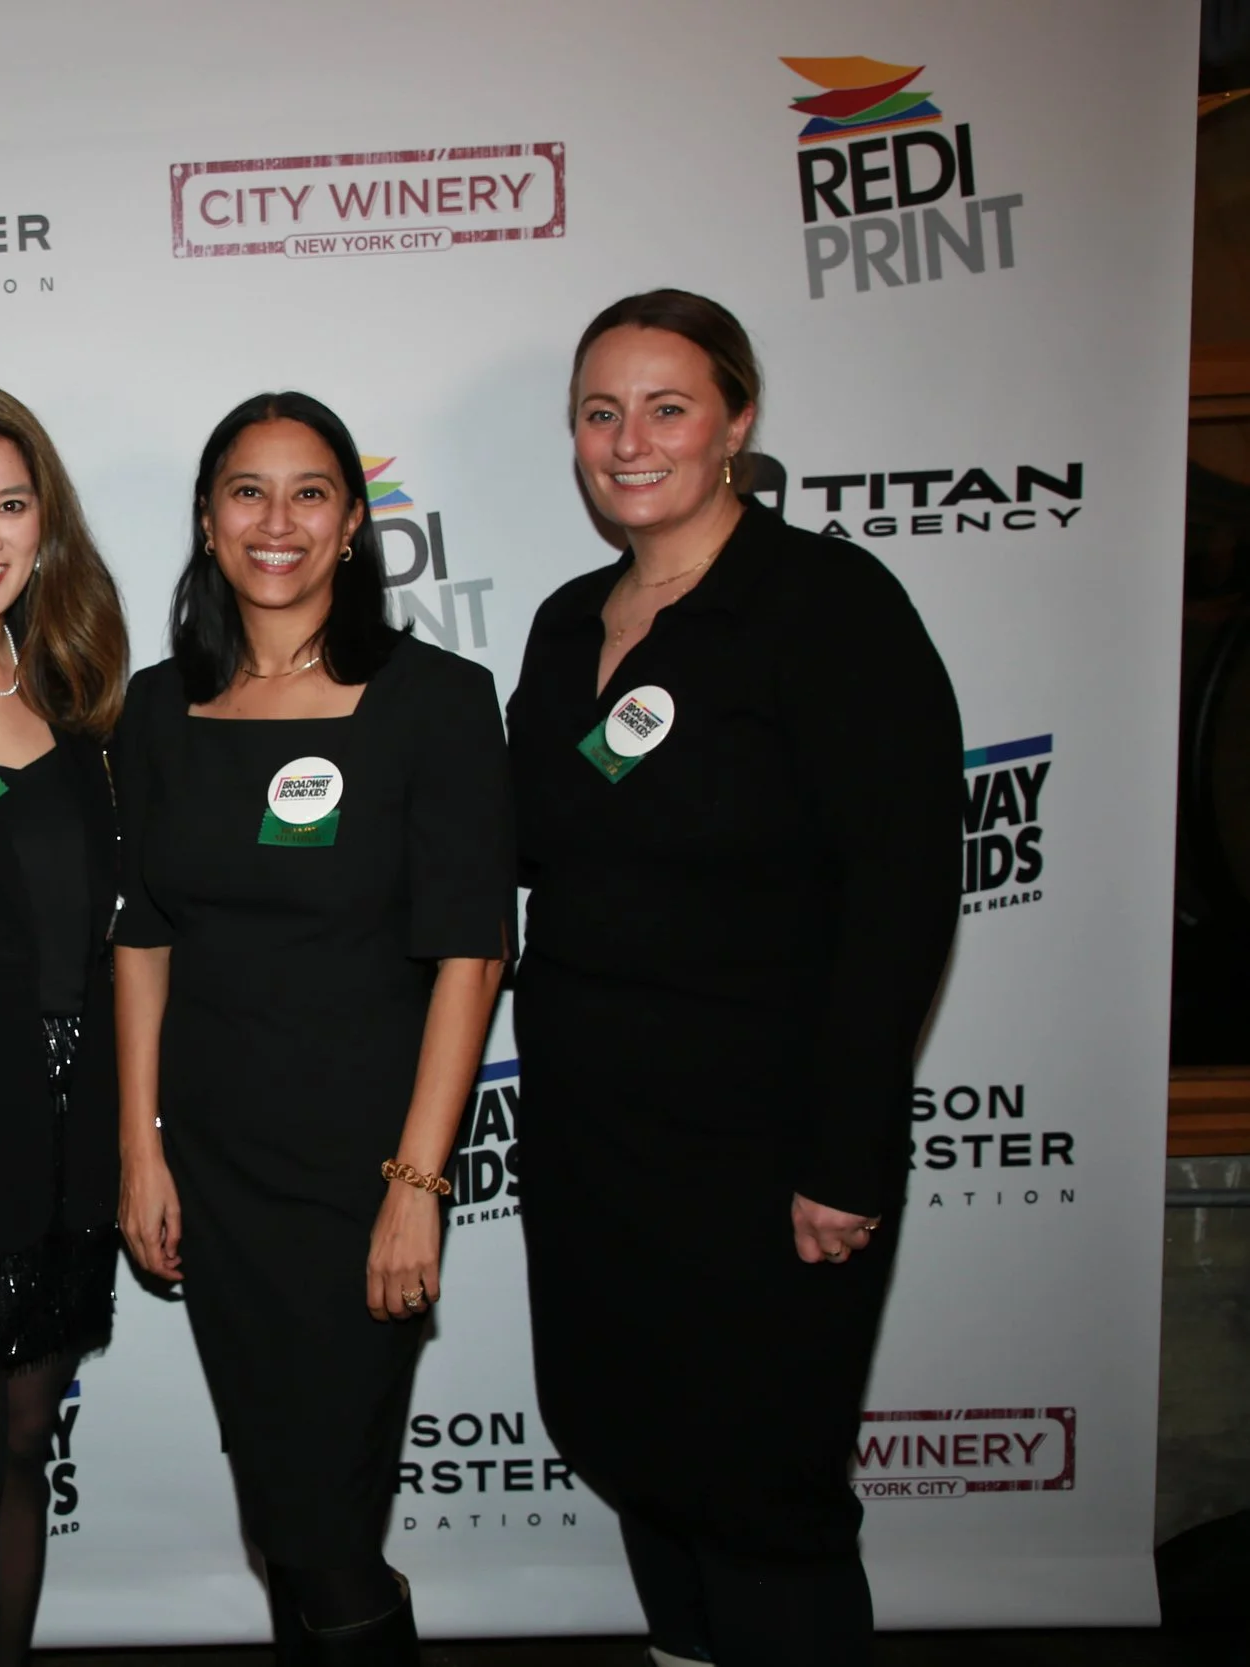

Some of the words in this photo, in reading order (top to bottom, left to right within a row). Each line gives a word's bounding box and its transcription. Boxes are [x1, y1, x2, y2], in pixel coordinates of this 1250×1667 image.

[797, 122, 975, 223] REDI
[200, 185, 314, 226] CITY
[329, 172, 536, 219] WINERY
[295, 238, 338, 256] NEW
[341, 235, 395, 253] YORK
[400, 232, 442, 249] CITY
[803, 193, 1023, 300] PRINT
[802, 462, 1083, 512] TITAN
[820, 507, 1082, 538] AGENCY
[625, 702, 660, 731] BROADWAY
[279, 788, 308, 798] BOUND
[308, 787, 327, 797] KIDS
[282, 779, 332, 790] BROADWAY
[962, 826, 1043, 894] IDS
[963, 901, 982, 915] BE
[988, 890, 1042, 911] HEARD
[910, 1132, 1075, 1170] STER
[457, 1213, 475, 1226] BE
[856, 1432, 1046, 1467] WINERY
[862, 1483, 912, 1497] YORK
[917, 1481, 958, 1495] CITY
